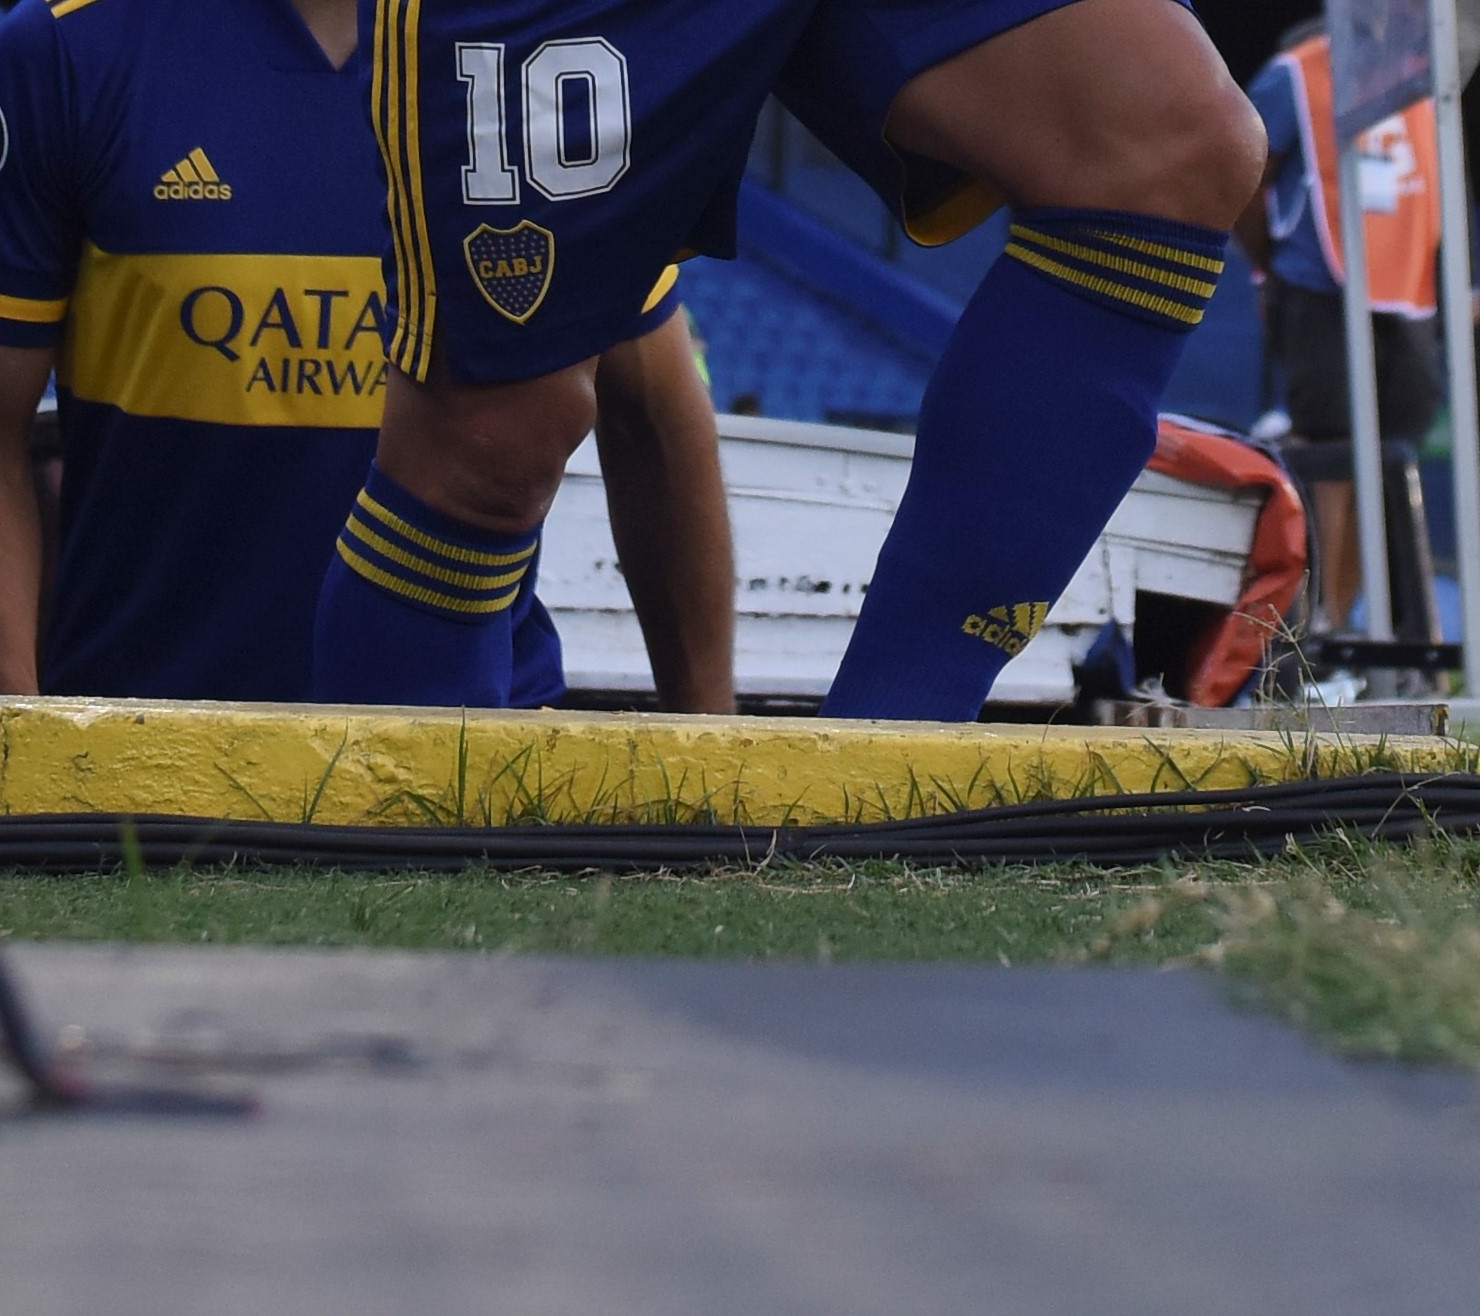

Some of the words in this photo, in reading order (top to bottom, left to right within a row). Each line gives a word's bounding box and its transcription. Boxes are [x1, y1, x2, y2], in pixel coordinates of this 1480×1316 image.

[455, 36, 632, 205] 10
[153, 181, 232, 200] adidas
[479, 255, 544, 280] CABJ
